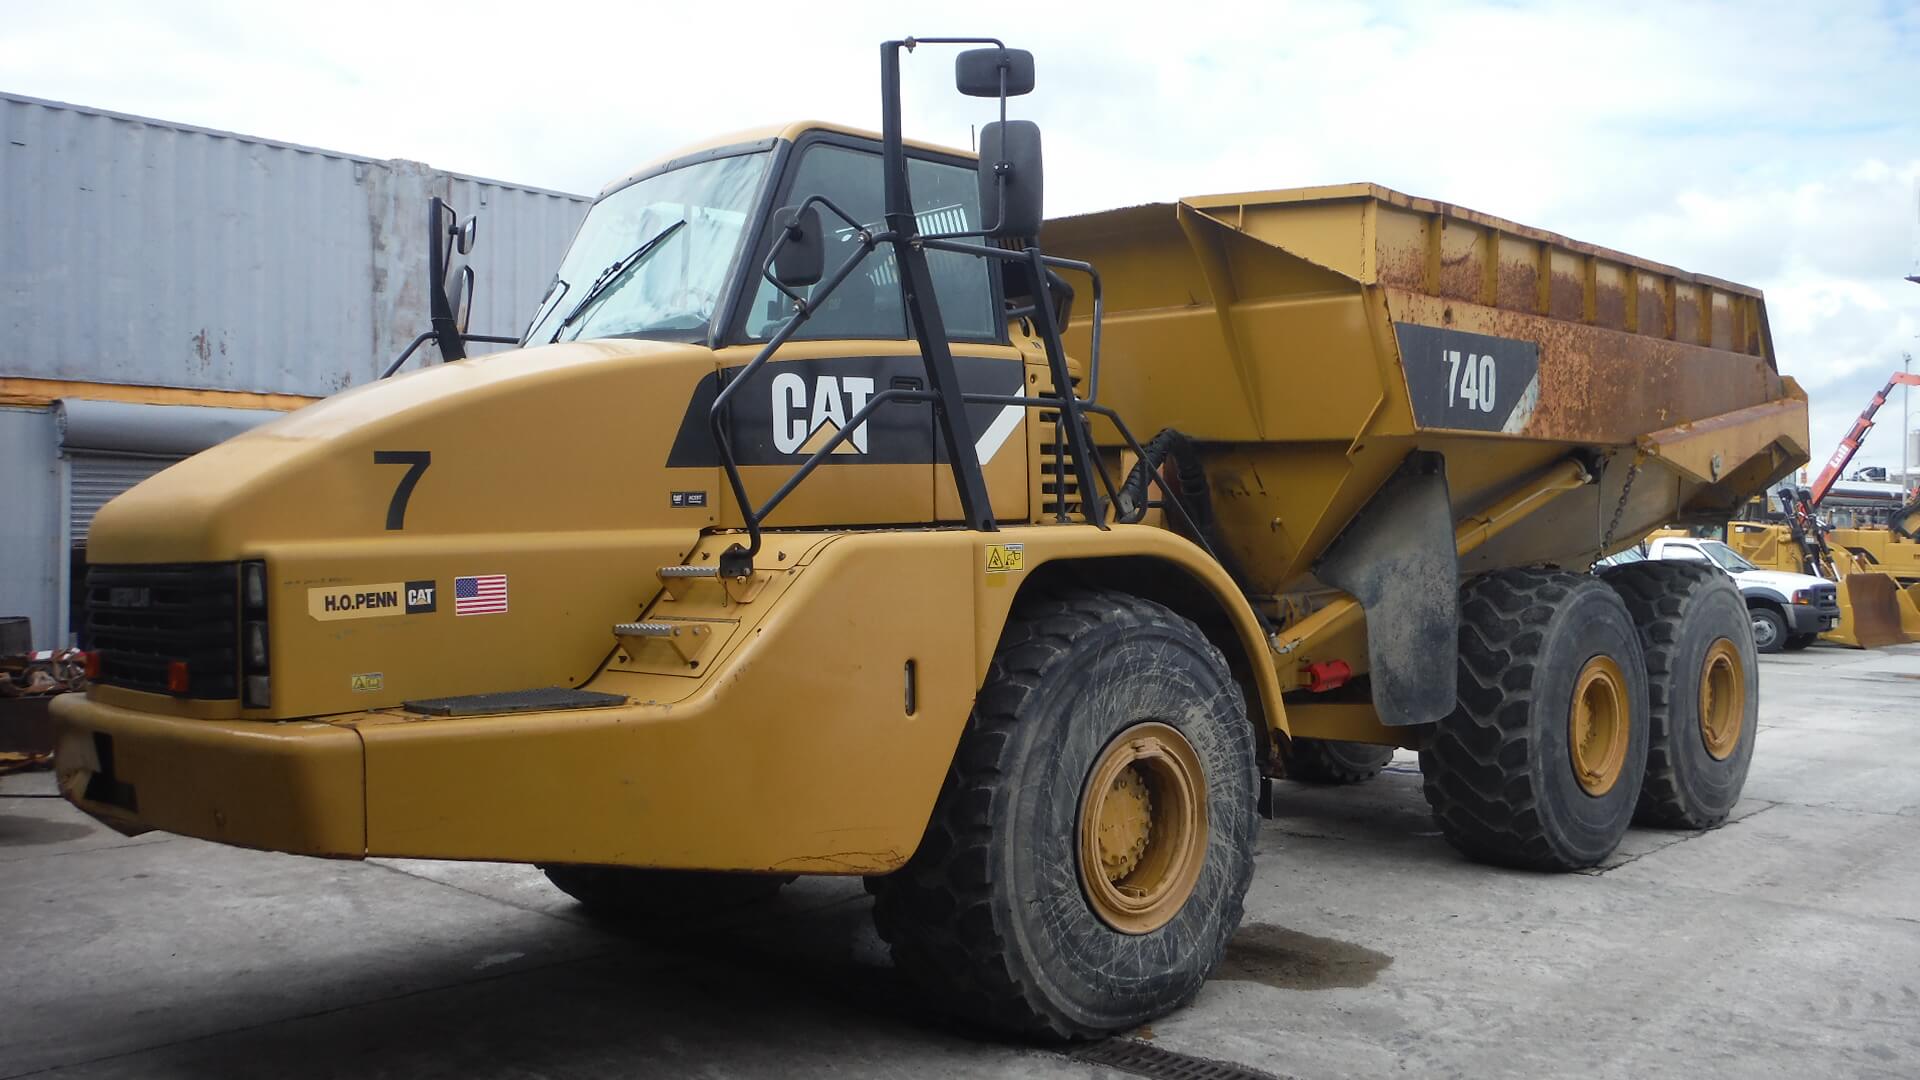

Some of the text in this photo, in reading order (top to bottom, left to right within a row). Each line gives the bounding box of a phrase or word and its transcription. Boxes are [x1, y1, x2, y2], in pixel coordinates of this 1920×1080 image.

[772, 372, 874, 455] CAT
[1443, 349, 1496, 413] 740
[373, 450, 432, 530] 7
[325, 588, 433, 612] H.O.PENN CAT
